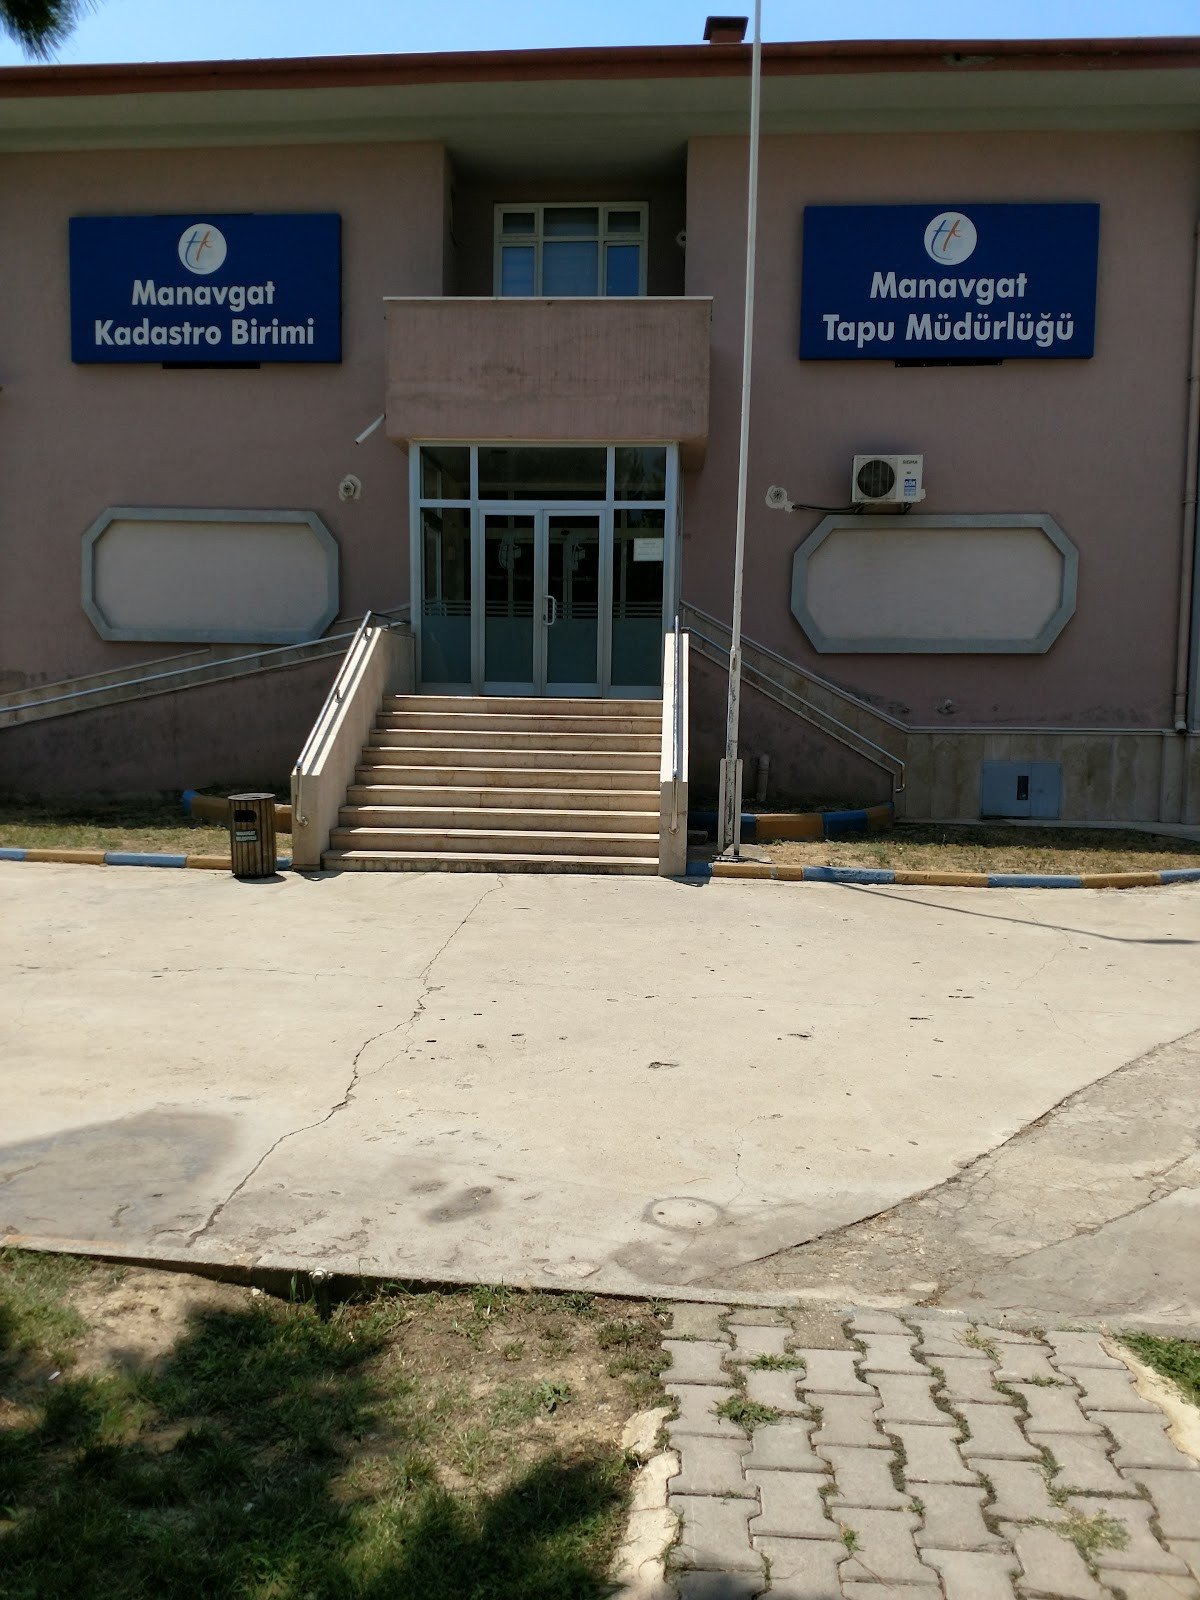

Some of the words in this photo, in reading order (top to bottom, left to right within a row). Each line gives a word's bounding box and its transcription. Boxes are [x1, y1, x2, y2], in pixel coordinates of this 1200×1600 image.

[132, 279, 276, 312] Manavgat
[870, 271, 1028, 306] Manavgat
[94, 318, 222, 346] Kadastro
[231, 317, 315, 345] Birimi
[822, 313, 896, 349] Tapu
[904, 311, 1075, 348] Müdürlüğü
